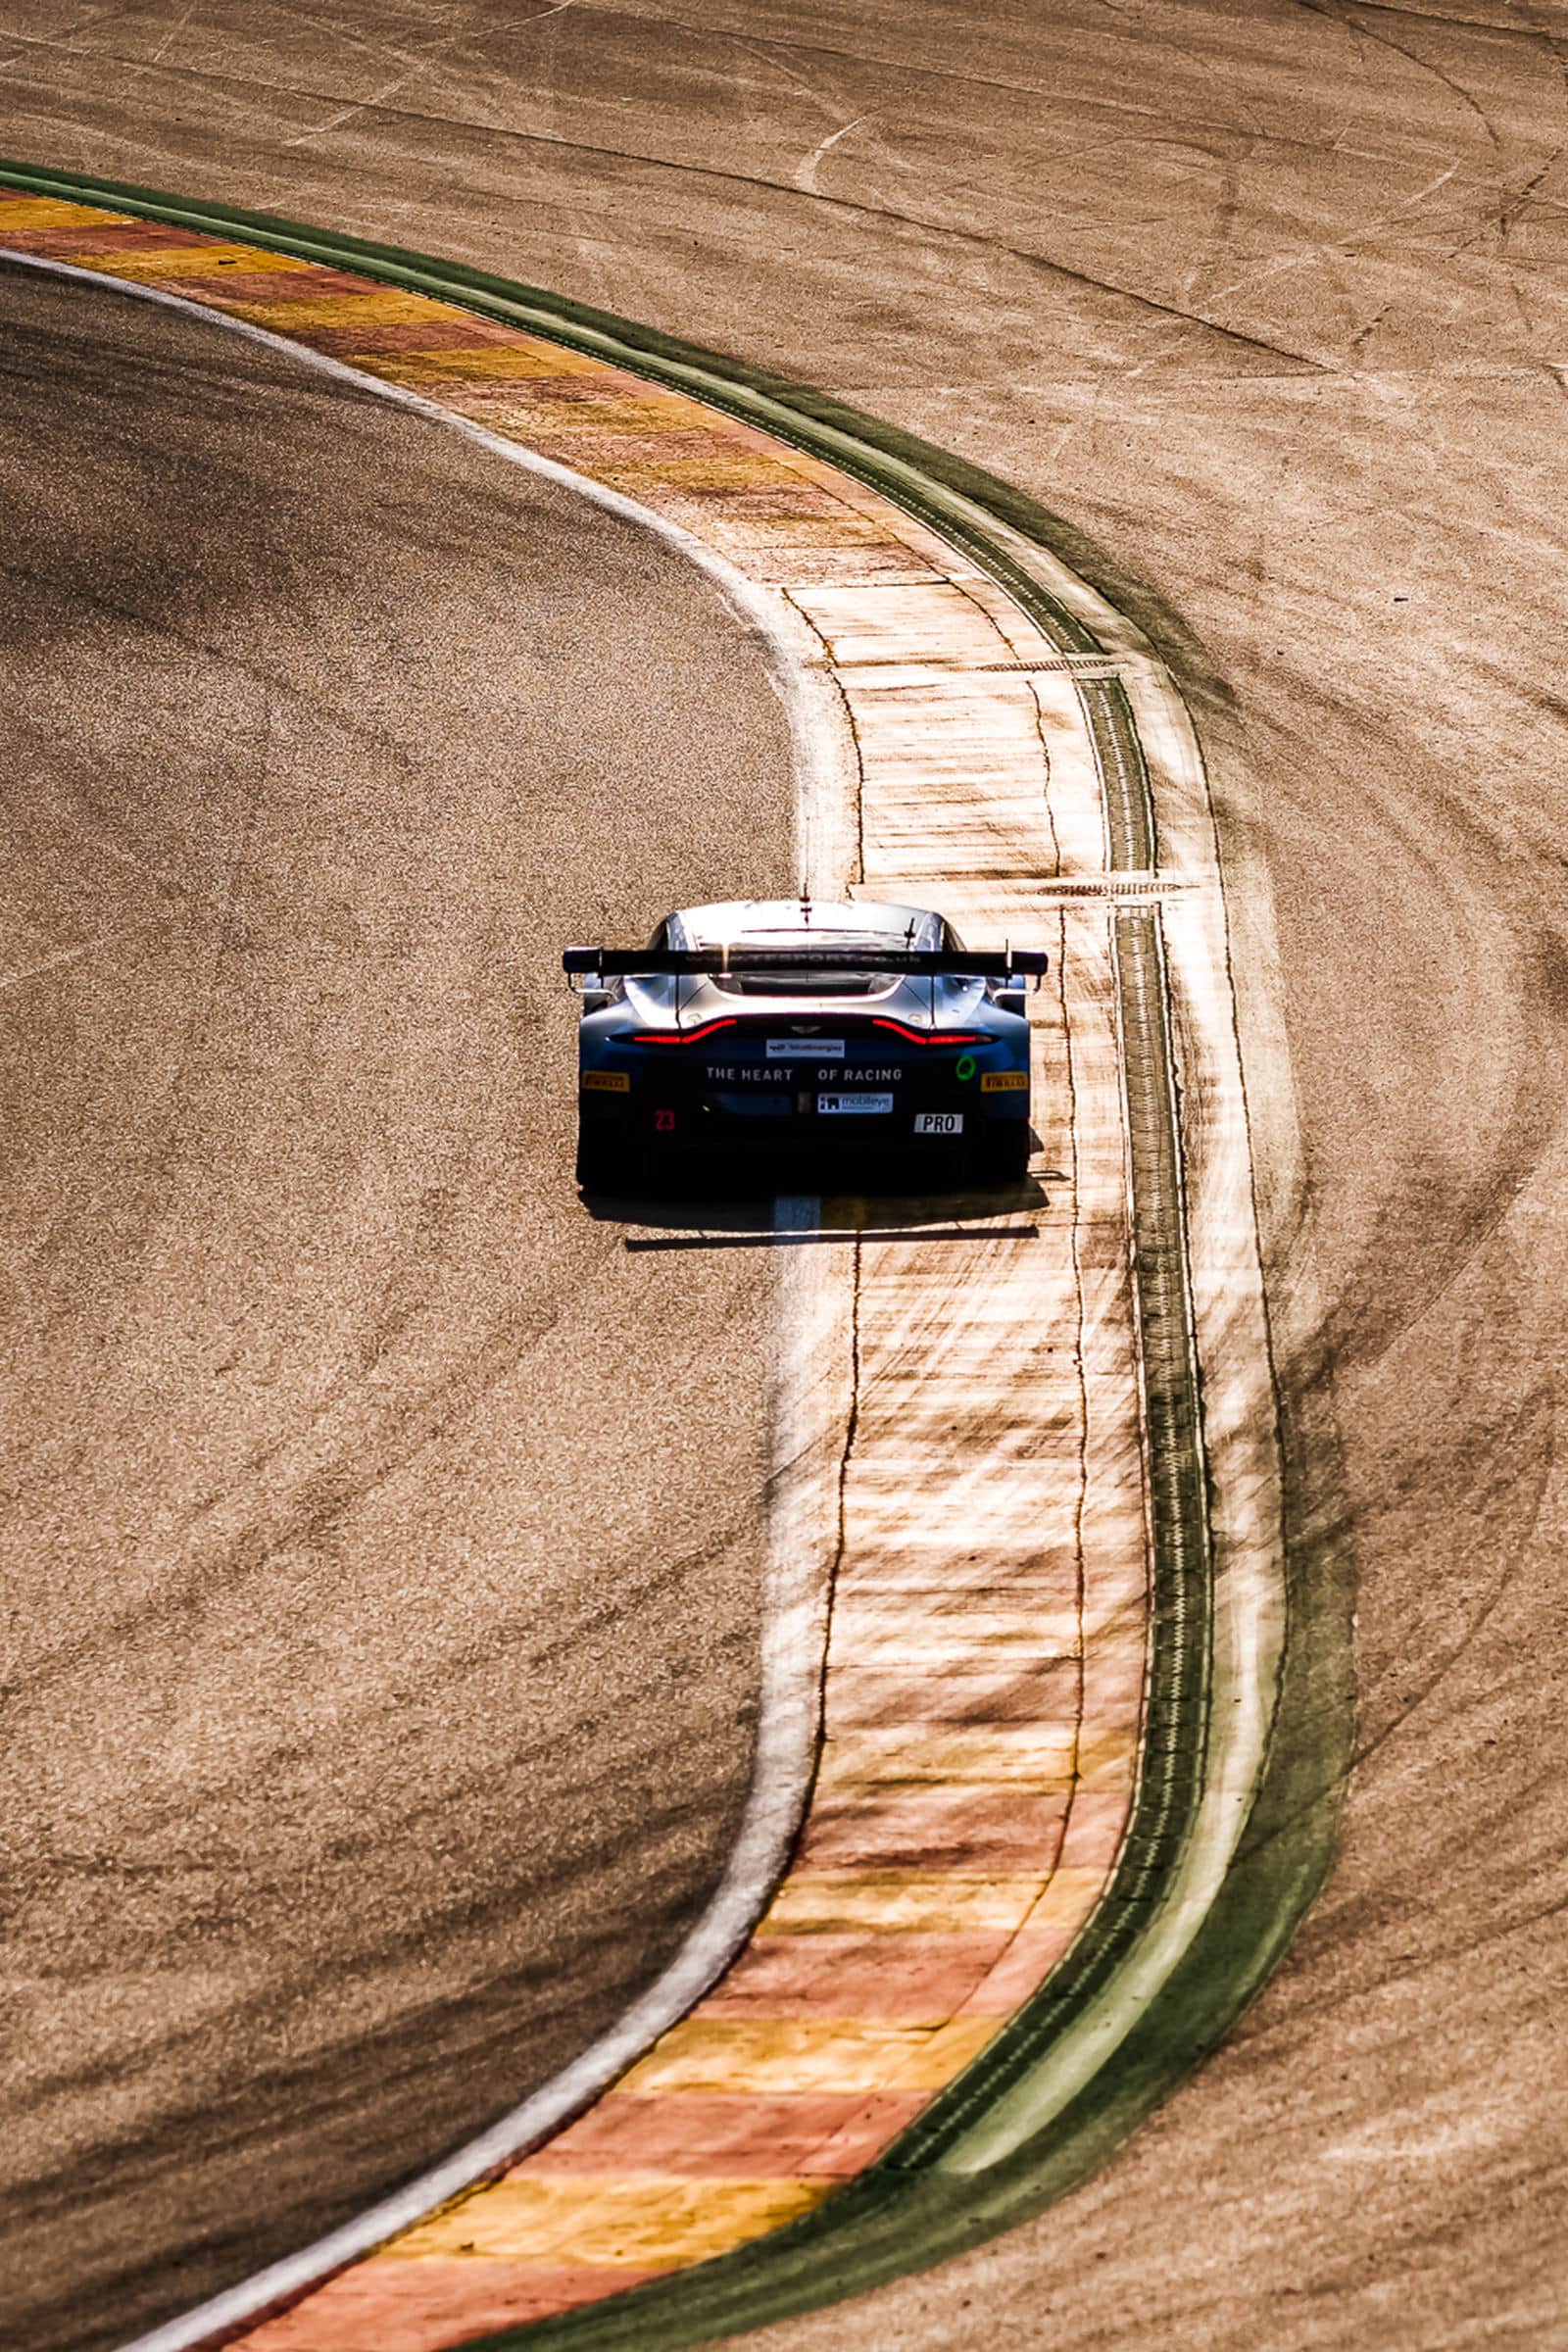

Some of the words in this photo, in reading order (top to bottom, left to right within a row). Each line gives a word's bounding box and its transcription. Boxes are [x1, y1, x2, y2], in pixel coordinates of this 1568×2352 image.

[707, 1067, 735, 1080] THE
[742, 1069, 793, 1081] HEART
[818, 1069, 838, 1081] OF
[844, 1068, 903, 1081] RACING
[842, 1095, 890, 1107] mobileye
[655, 1108, 675, 1130] 23
[923, 1115, 956, 1132] PRO
